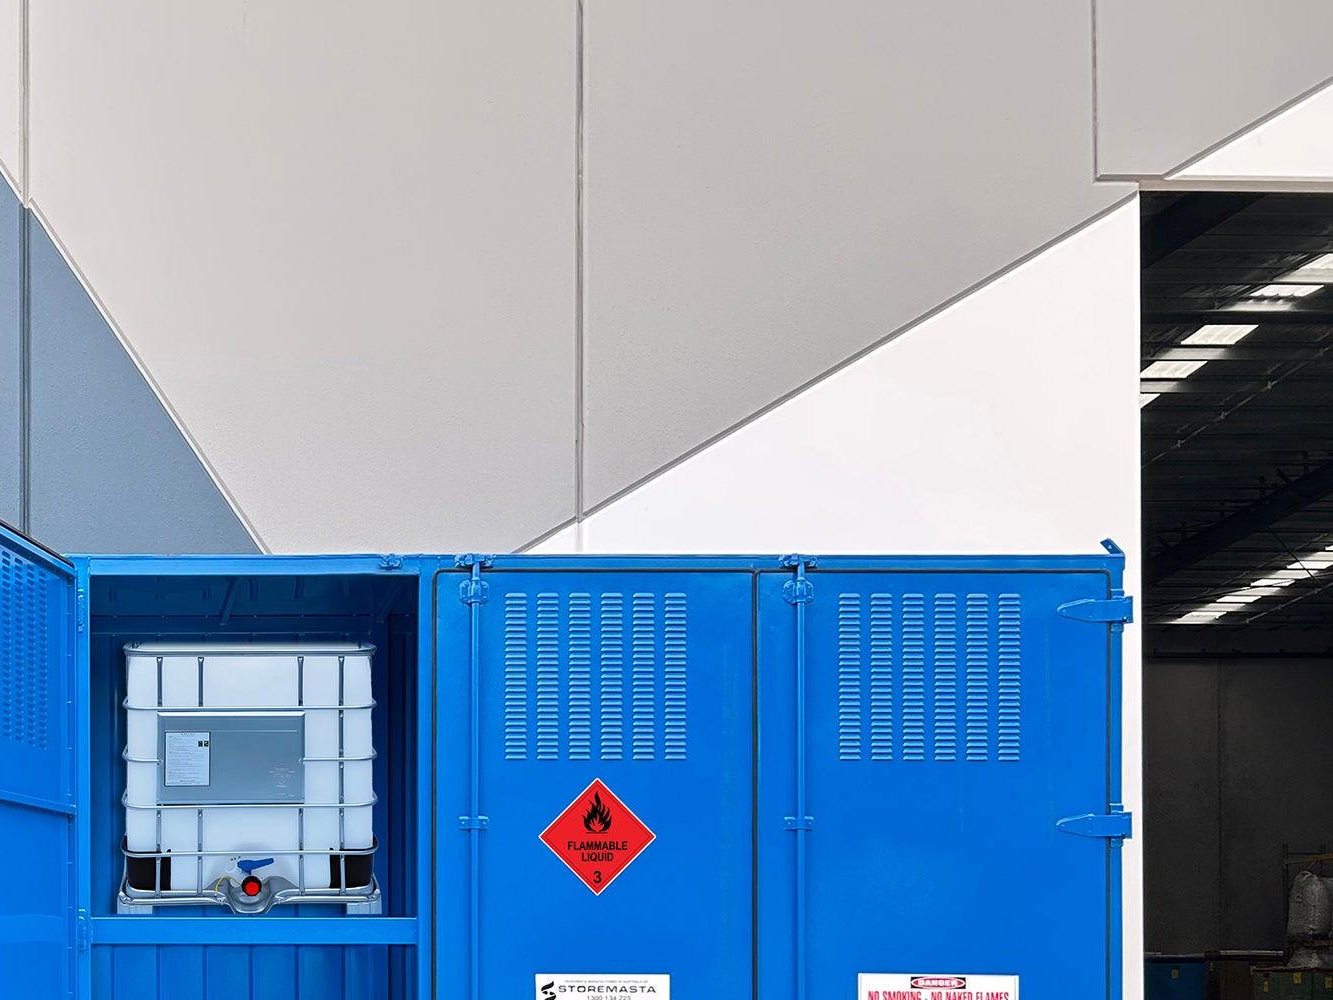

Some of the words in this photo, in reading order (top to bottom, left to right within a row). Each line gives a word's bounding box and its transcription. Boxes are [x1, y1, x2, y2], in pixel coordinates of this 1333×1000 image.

[567, 841, 628, 850] FLAMMABLE
[581, 852, 614, 862] LIQUID
[593, 870, 602, 884] 3
[918, 979, 958, 987] DANGER
[558, 985, 657, 993] STOREMASTA
